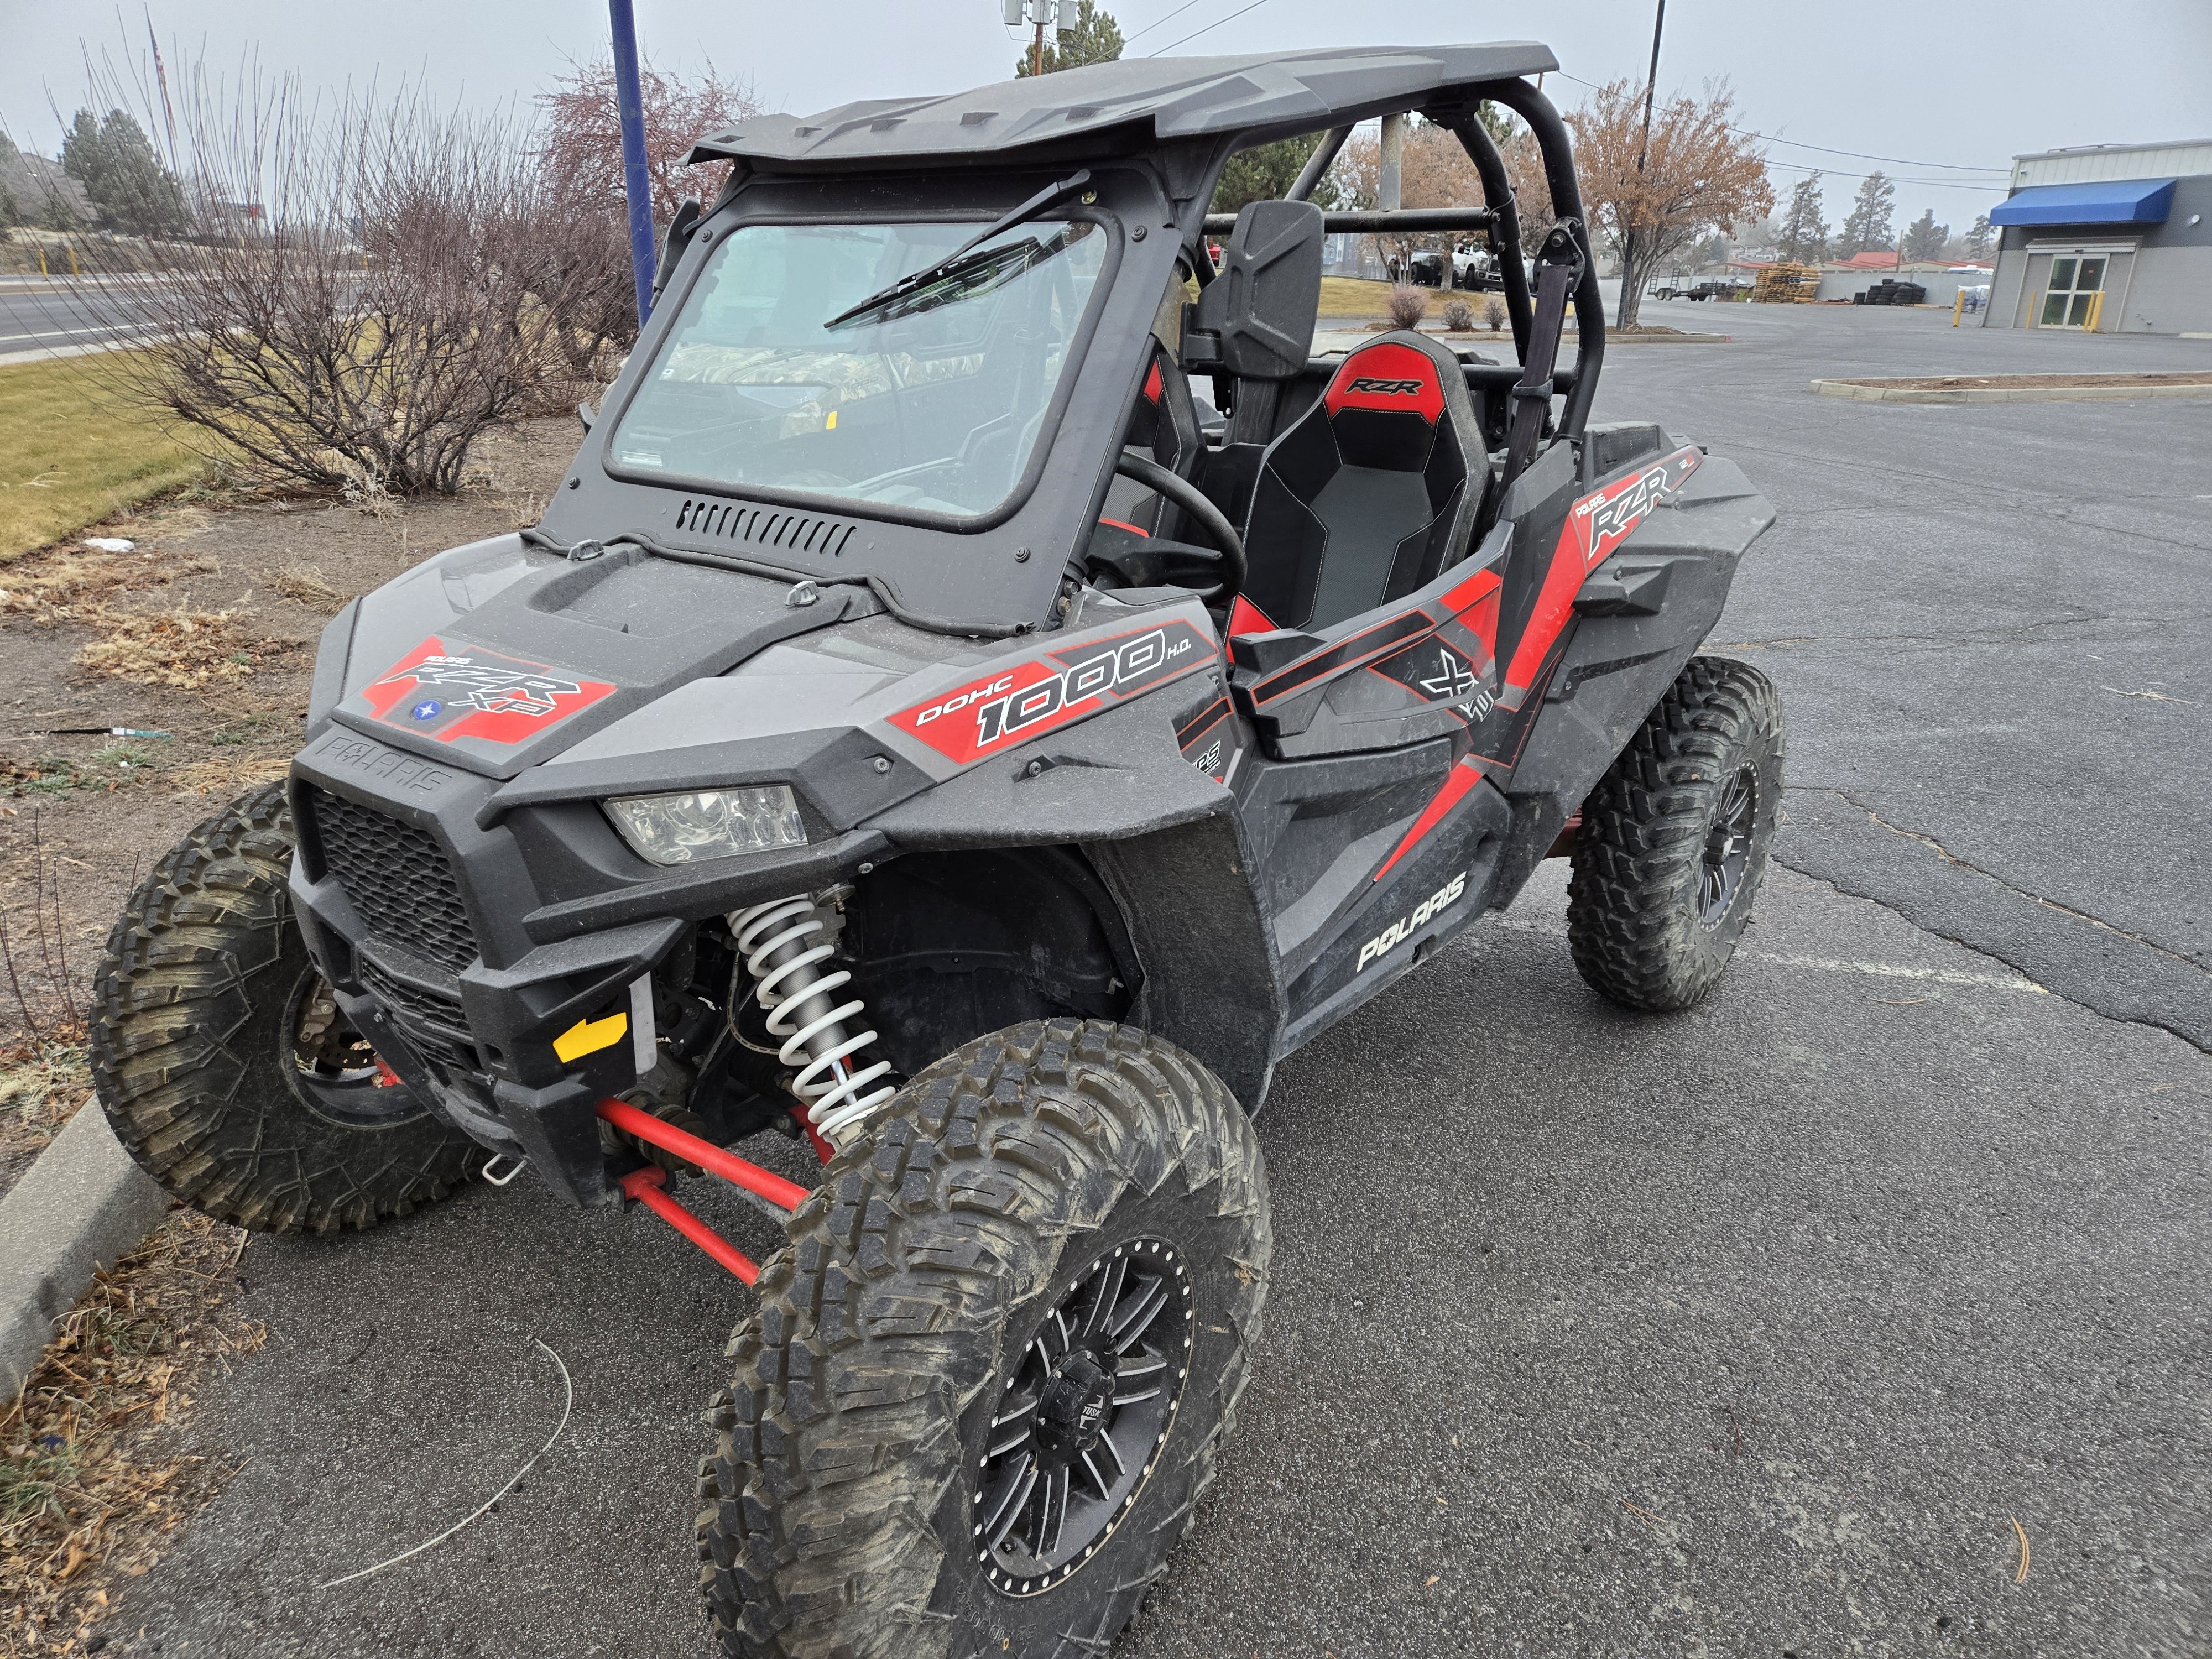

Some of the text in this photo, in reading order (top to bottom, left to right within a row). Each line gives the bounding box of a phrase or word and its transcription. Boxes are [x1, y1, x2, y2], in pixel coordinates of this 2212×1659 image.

[1344, 377, 1424, 396] RZR
[1575, 493, 1606, 519] POLARIS
[1588, 466, 1672, 561] RZR
[424, 655, 473, 664] POLARIS
[376, 662, 582, 706] RZR
[916, 629, 1192, 748] DOHC 1000 H.O.
[447, 691, 556, 717] XP
[315, 736, 453, 791] POLARIS
[1357, 871, 1467, 973] POLARIS
[1082, 1406, 1102, 1418] TUSK
